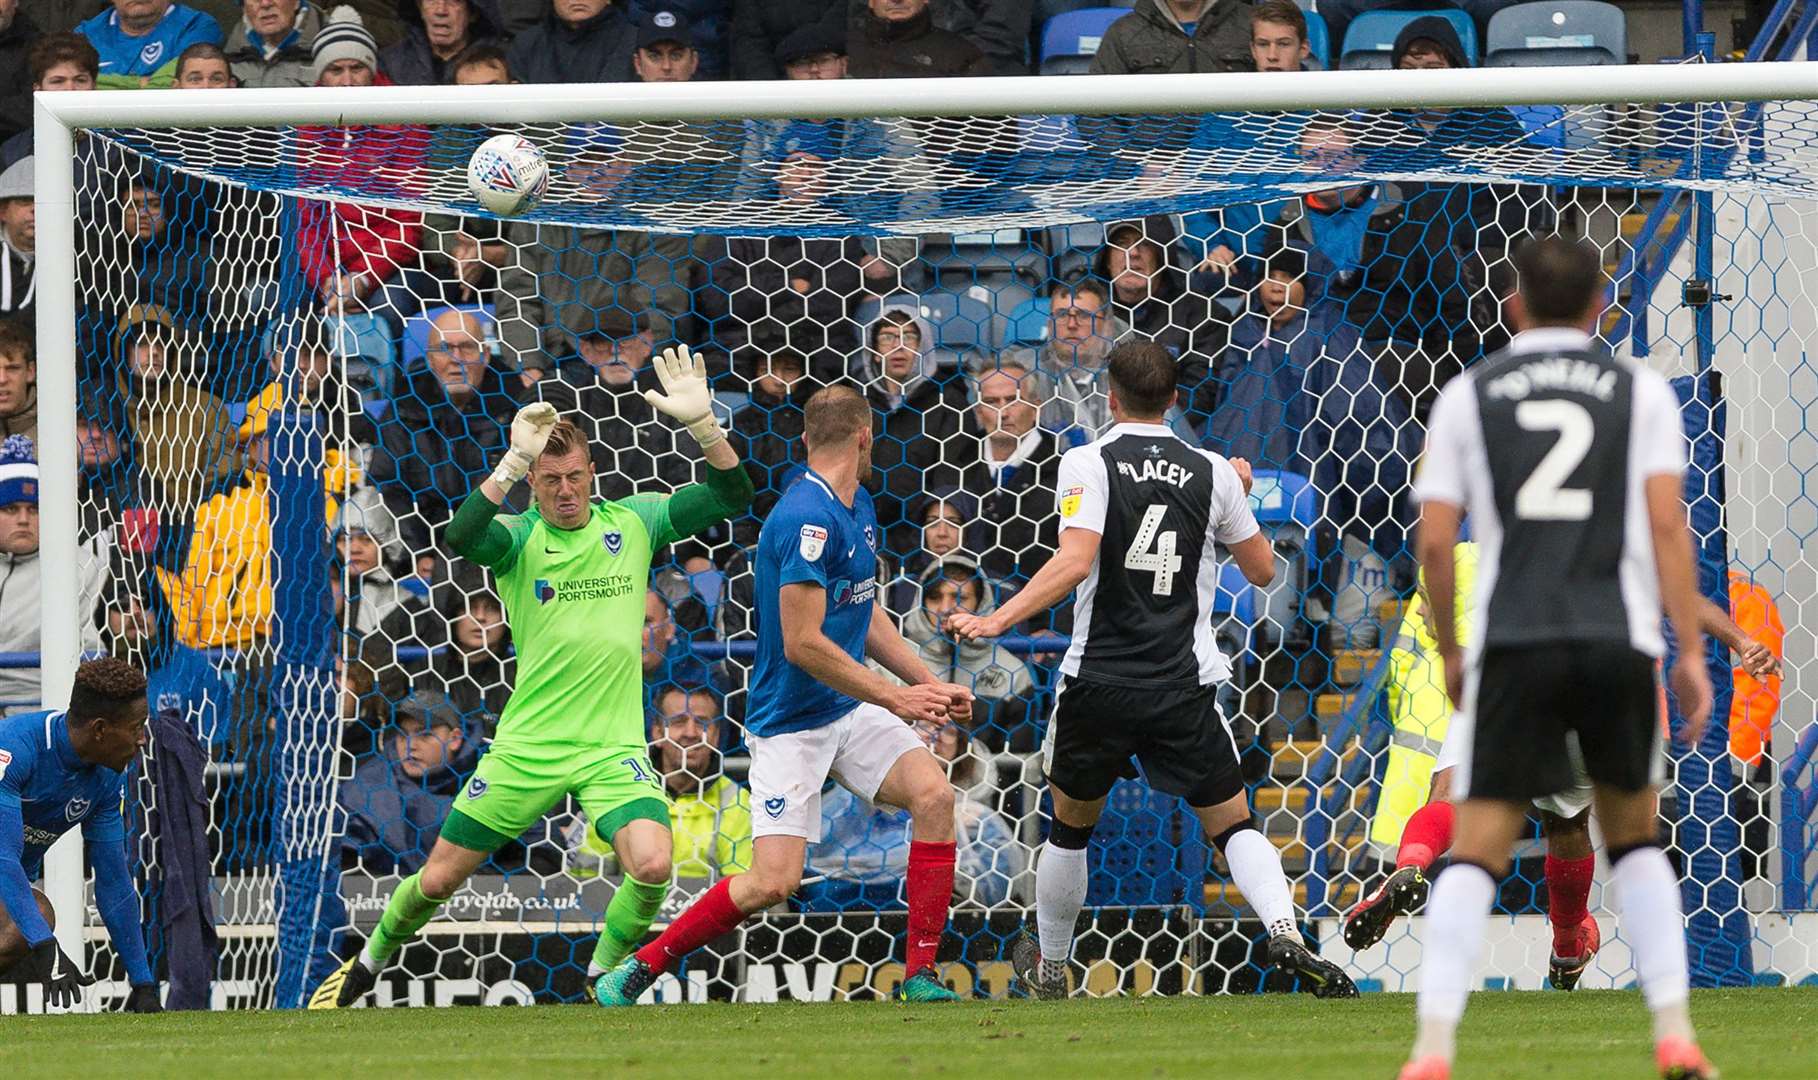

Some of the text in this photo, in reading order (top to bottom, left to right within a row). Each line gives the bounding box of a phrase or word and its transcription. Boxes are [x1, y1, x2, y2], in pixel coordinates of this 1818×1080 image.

[519, 157, 543, 176] mitre
[1514, 398, 1595, 521] 2
[1127, 459, 1194, 489] LACEY
[1124, 504, 1182, 596] 4
[557, 574, 632, 592] UNIVERSITY OF
[557, 584, 633, 602] PORTSMOUTH
